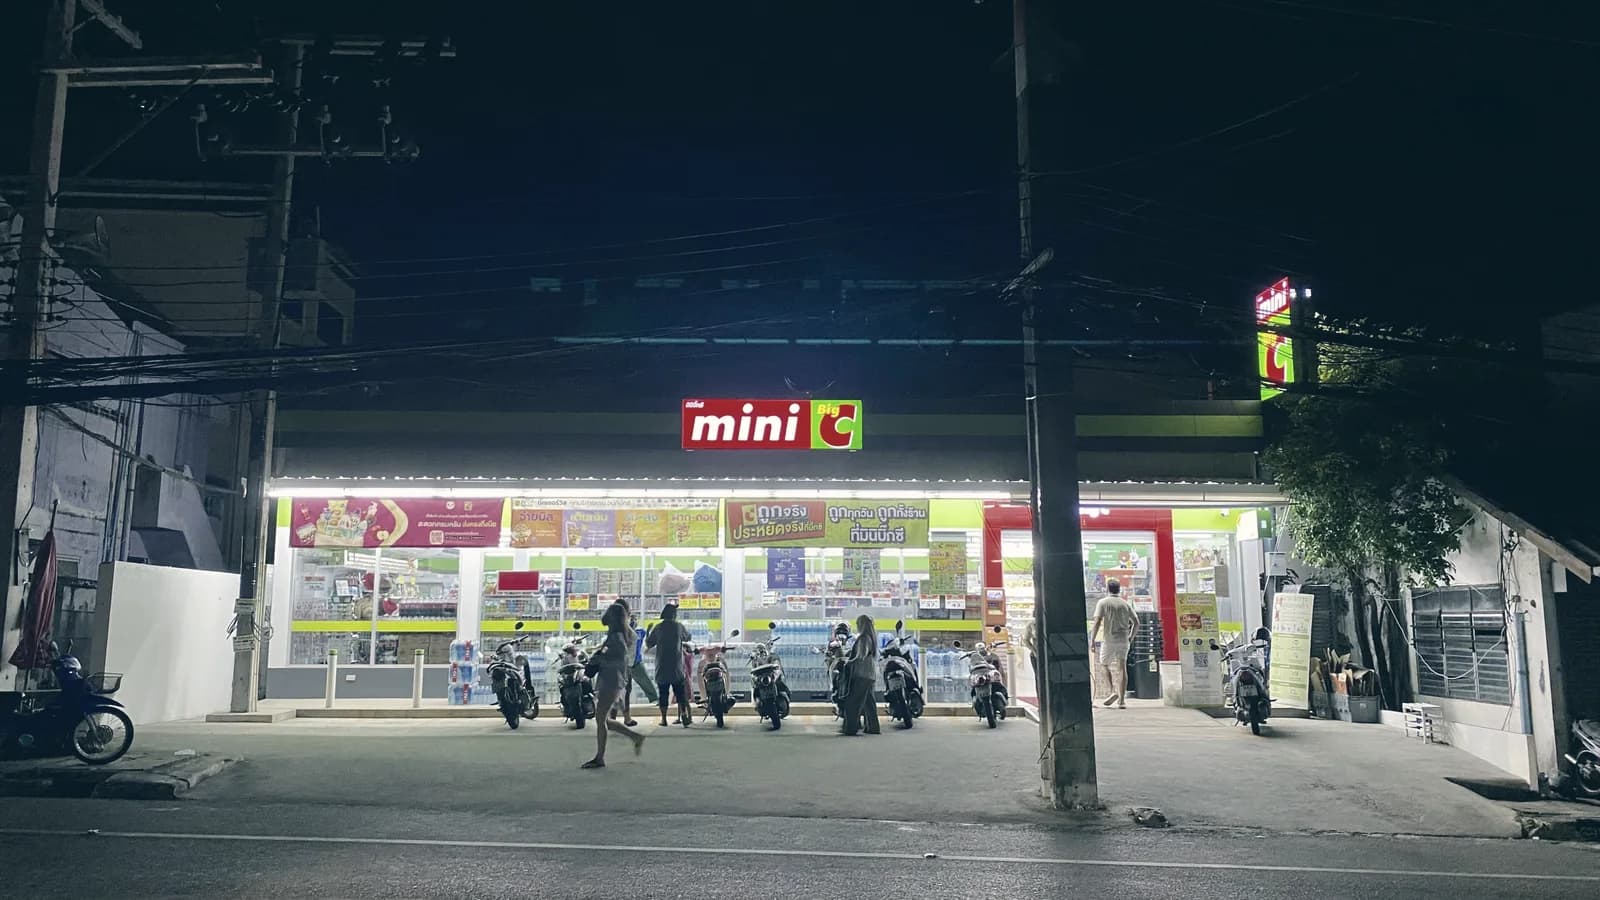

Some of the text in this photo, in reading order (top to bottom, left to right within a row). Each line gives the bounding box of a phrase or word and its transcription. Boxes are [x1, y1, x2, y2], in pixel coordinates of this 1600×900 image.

[817, 404, 840, 417] Big
[691, 403, 801, 442] mini
[758, 504, 807, 524] ถูกจริง
[829, 503, 925, 522] ถูกทุกวัน ถูกทั้งร้าน
